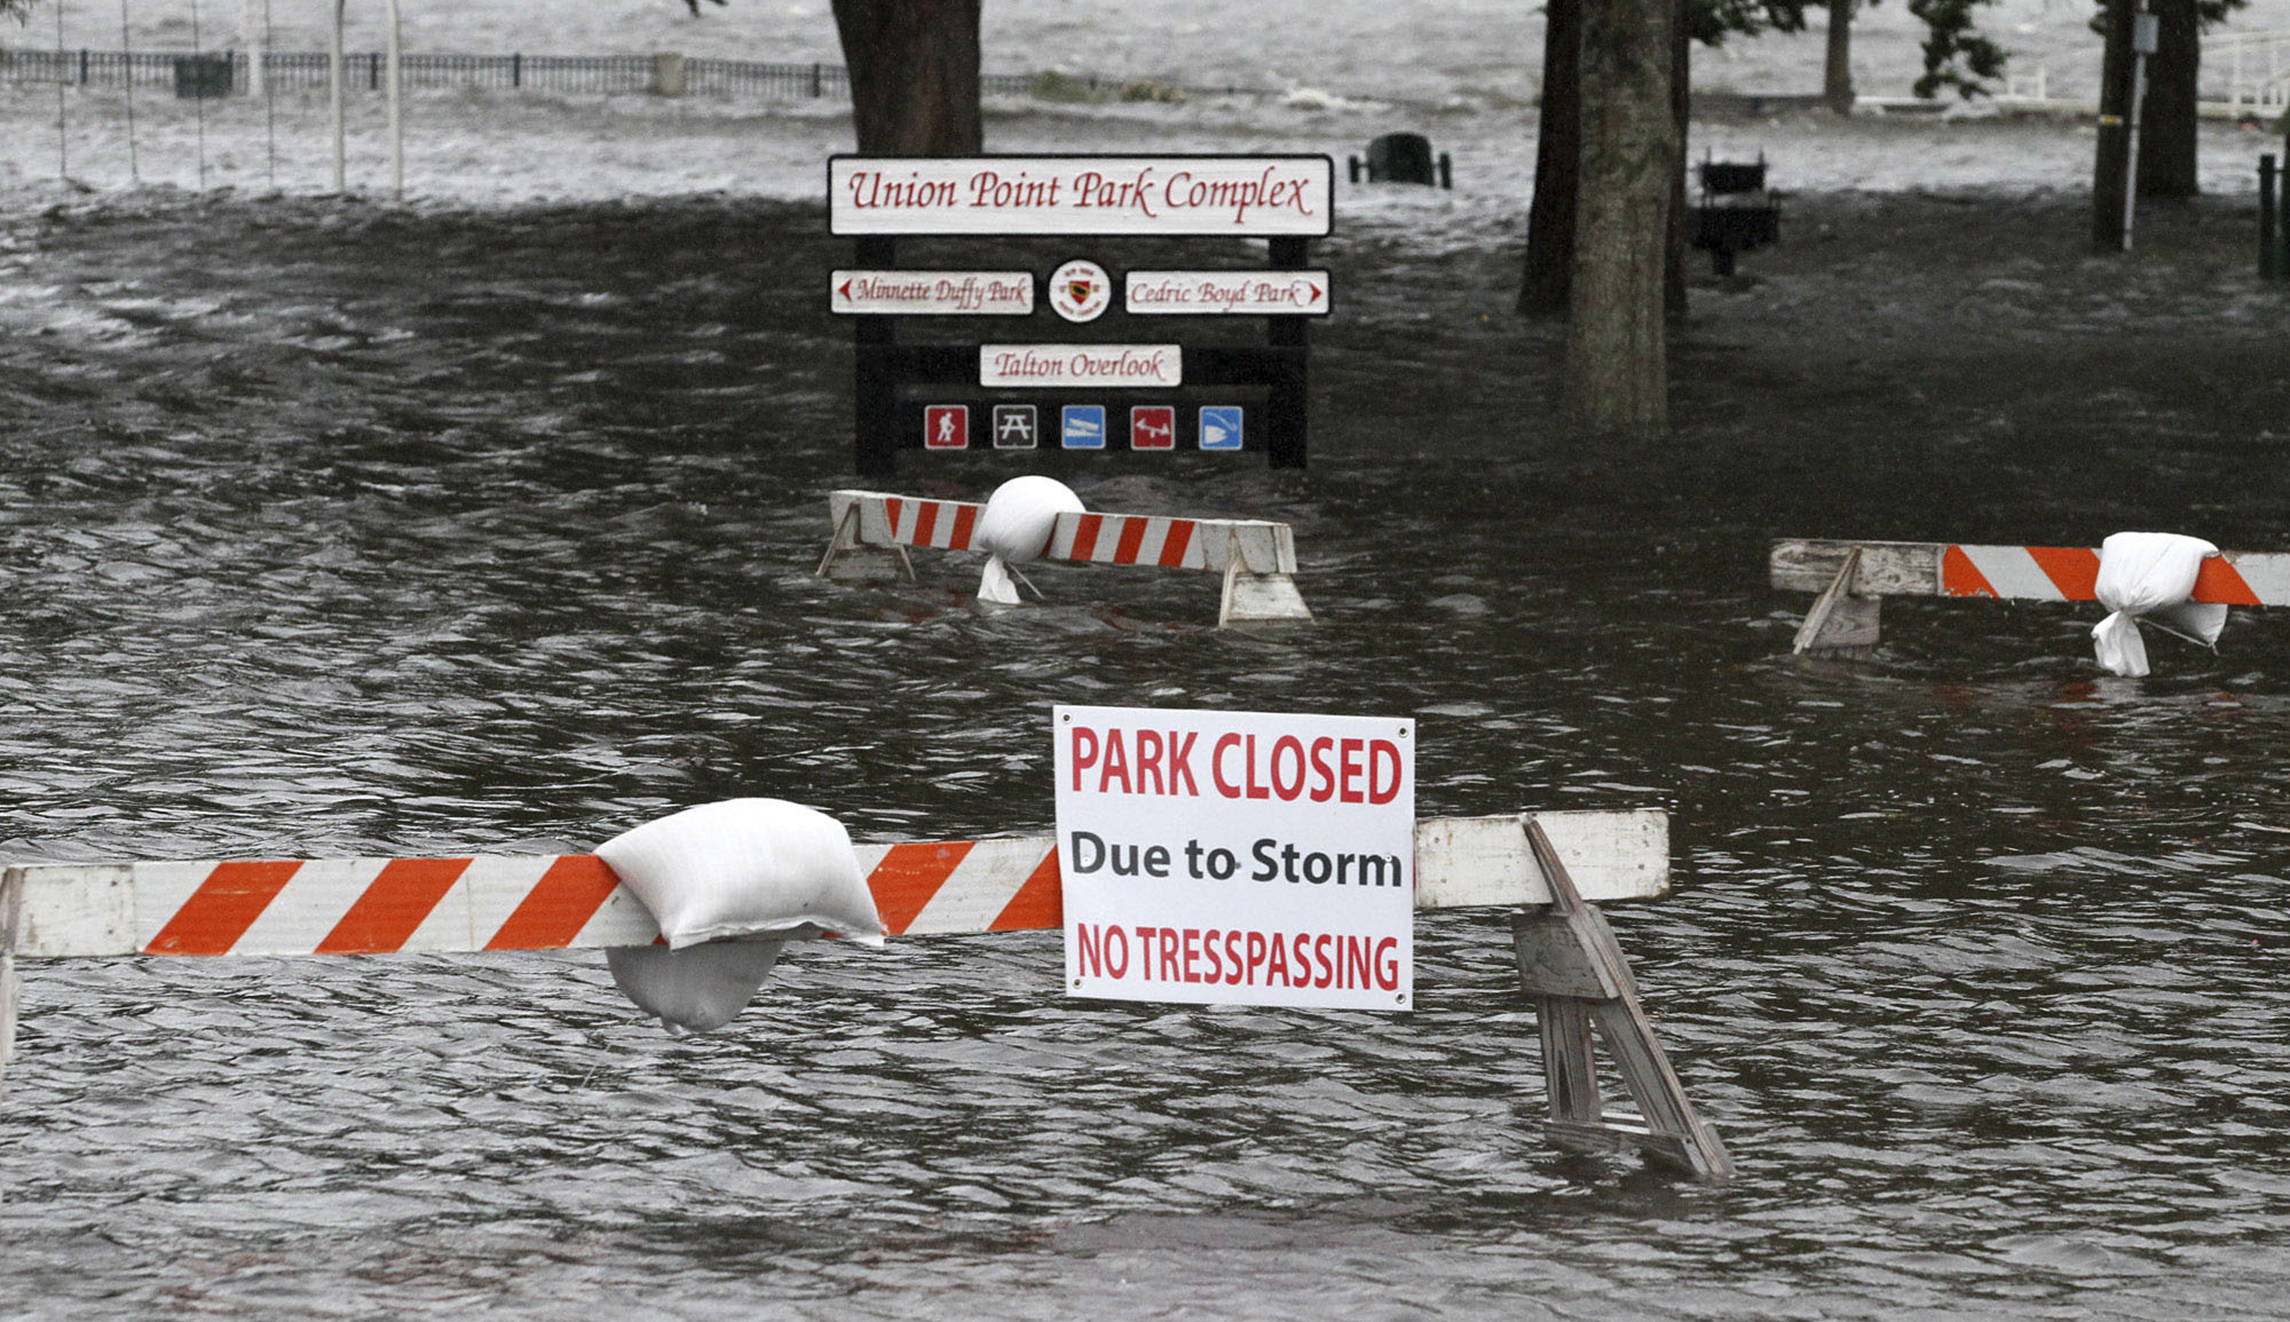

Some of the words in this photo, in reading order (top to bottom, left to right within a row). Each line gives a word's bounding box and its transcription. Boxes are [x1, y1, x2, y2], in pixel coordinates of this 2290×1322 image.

[849, 171, 957, 209] Union
[969, 171, 1063, 208] Point
[1074, 166, 1157, 219] Park
[1165, 165, 1313, 224] Complex
[857, 277, 931, 302] Minnette
[935, 277, 986, 311] Duffy
[988, 278, 1028, 306] Park
[1131, 281, 1191, 304] Cedric
[1197, 280, 1251, 311] Boyd
[1254, 280, 1304, 307] Park
[995, 350, 1064, 378] Talton
[1070, 349, 1166, 381] Overlook
[1072, 726, 1200, 797] PARK
[1212, 732, 1403, 805] CLOSED
[1071, 831, 1171, 878] Due
[1185, 839, 1235, 881] to
[1251, 838, 1402, 887] Storm
[1078, 922, 1130, 980] NO
[1136, 926, 1399, 992] TRESSPASSING
